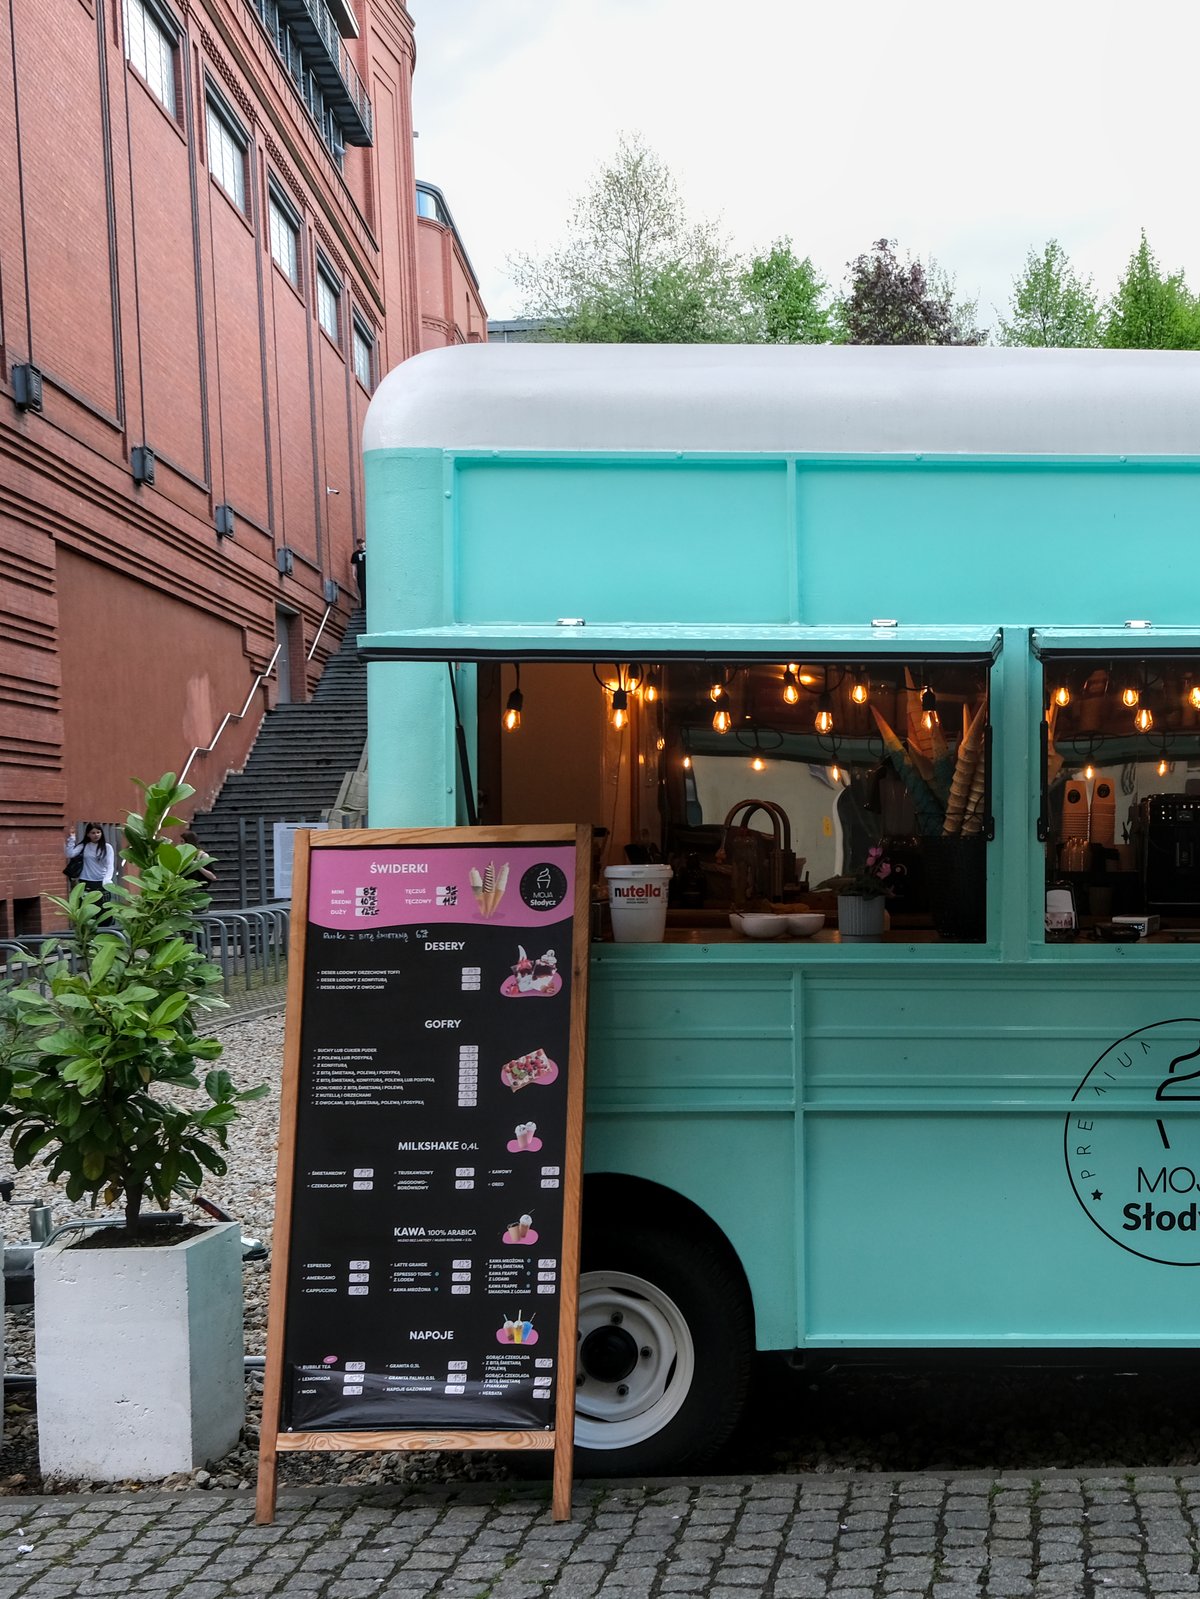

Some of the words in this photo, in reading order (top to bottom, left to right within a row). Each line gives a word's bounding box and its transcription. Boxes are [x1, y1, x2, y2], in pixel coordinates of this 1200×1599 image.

[370, 862, 429, 874] ŚWIDERKI
[614, 884, 661, 898] nutella
[530, 899, 557, 907] Słodycz
[425, 942, 466, 951] DESERY
[424, 1019, 462, 1029] GOFRY
[398, 1141, 459, 1151] MILKSHAKE
[461, 1142, 479, 1151] 0,4L
[394, 1227, 426, 1236] KAWA
[409, 1330, 454, 1340] NAPOJE
